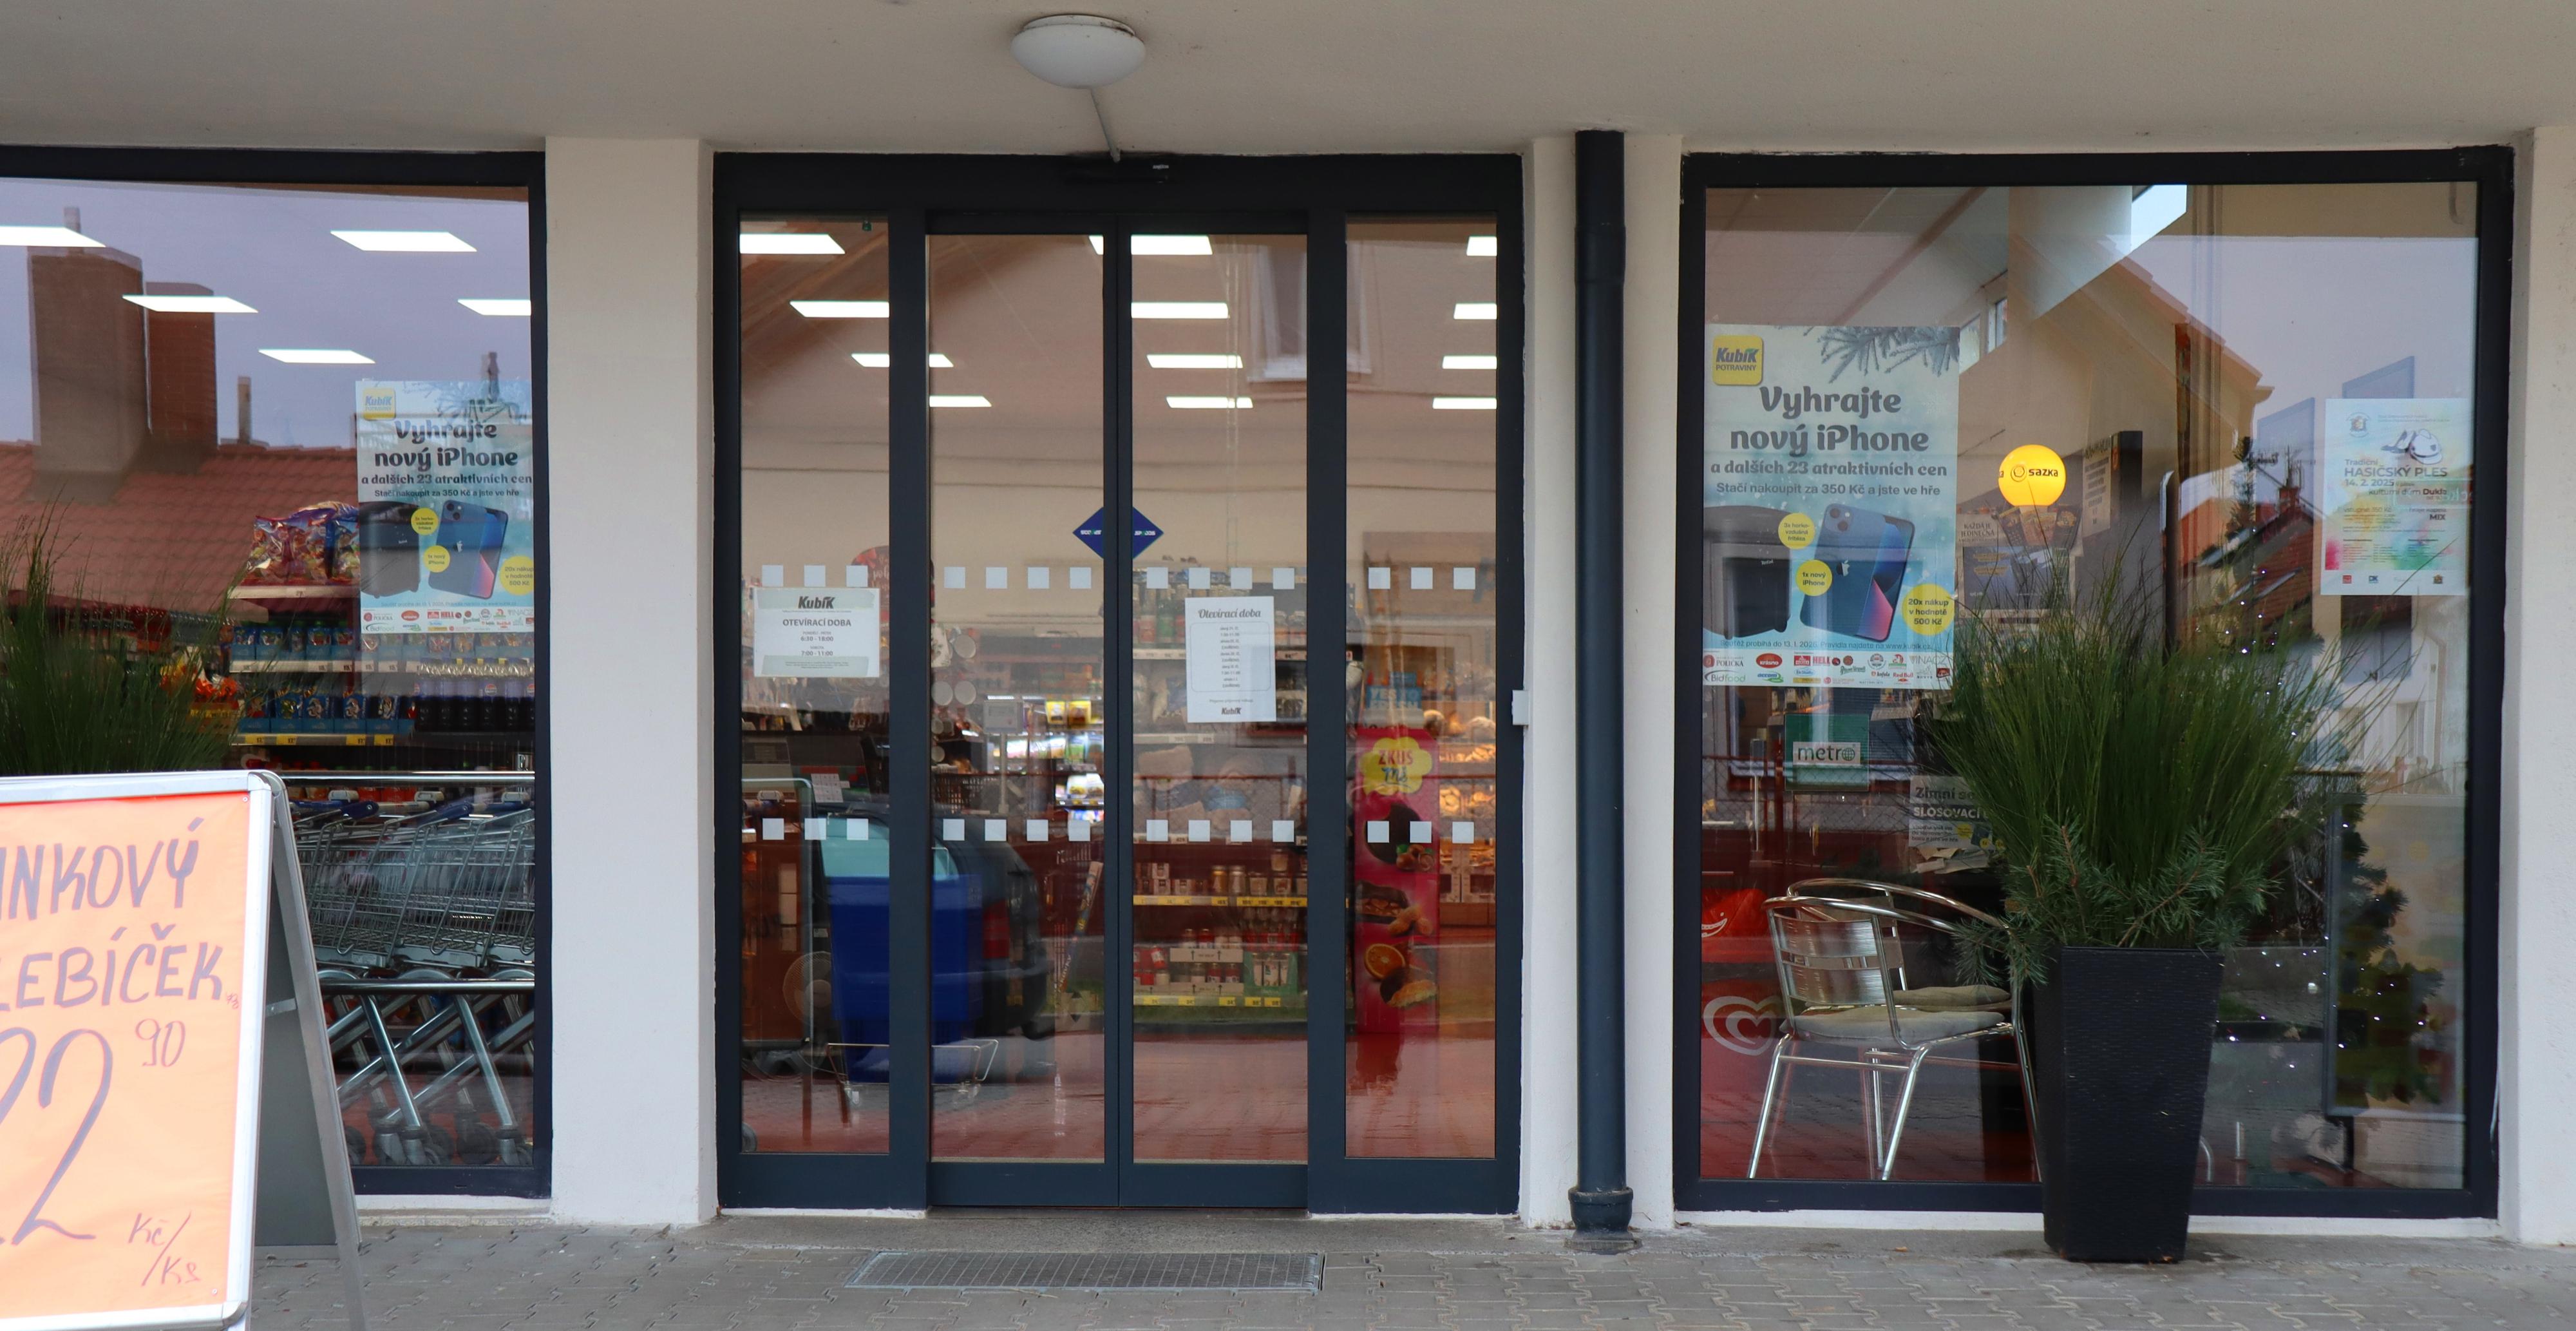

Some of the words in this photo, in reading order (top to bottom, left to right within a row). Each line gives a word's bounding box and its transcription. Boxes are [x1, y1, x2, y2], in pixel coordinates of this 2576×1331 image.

[1759, 386, 1902, 419] Vyhrajte
[394, 420, 498, 445] Vyhrajte
[1730, 423, 1808, 457] nový
[1816, 424, 1929, 452] iPhone
[375, 447, 431, 472] nový
[437, 447, 519, 467] iPhone
[1710, 463, 1721, 473] a
[1724, 459, 1783, 474] dalších
[1787, 461, 1809, 474] 23
[1812, 461, 1914, 476] atraktivních
[1917, 464, 1947, 476] cen
[2344, 464, 2411, 477] HASIČSKÝ
[2414, 466, 2448, 477] PLES
[371, 474, 414, 484] dalších
[417, 474, 432, 484] 23
[435, 474, 508, 484] atraktivních
[511, 475, 533, 484] cen
[396, 490, 430, 499] nakoupit
[1716, 482, 1747, 493] Stačí
[1750, 483, 1802, 497] nakoupit
[1821, 484, 1846, 494] 350
[1849, 483, 1865, 494] Kč
[1877, 484, 1900, 497] jste
[1903, 486, 1917, 495] ve
[1920, 483, 1941, 496] hře
[1908, 598, 1923, 606] 20x
[1924, 597, 1949, 609] nákup
[1198, 608, 1238, 618] Otevírací
[1239, 608, 1261, 618] doba
[1915, 607, 1947, 617] hodnotě
[782, 617, 826, 627] OTEVÍRACÍ
[1913, 617, 1930, 626] 500
[1931, 617, 1942, 626] Kč
[1711, 674, 1746, 683] Bidfood
[1378, 749, 1413, 765] ZKUS
[135, 1018, 186, 1068] 90
